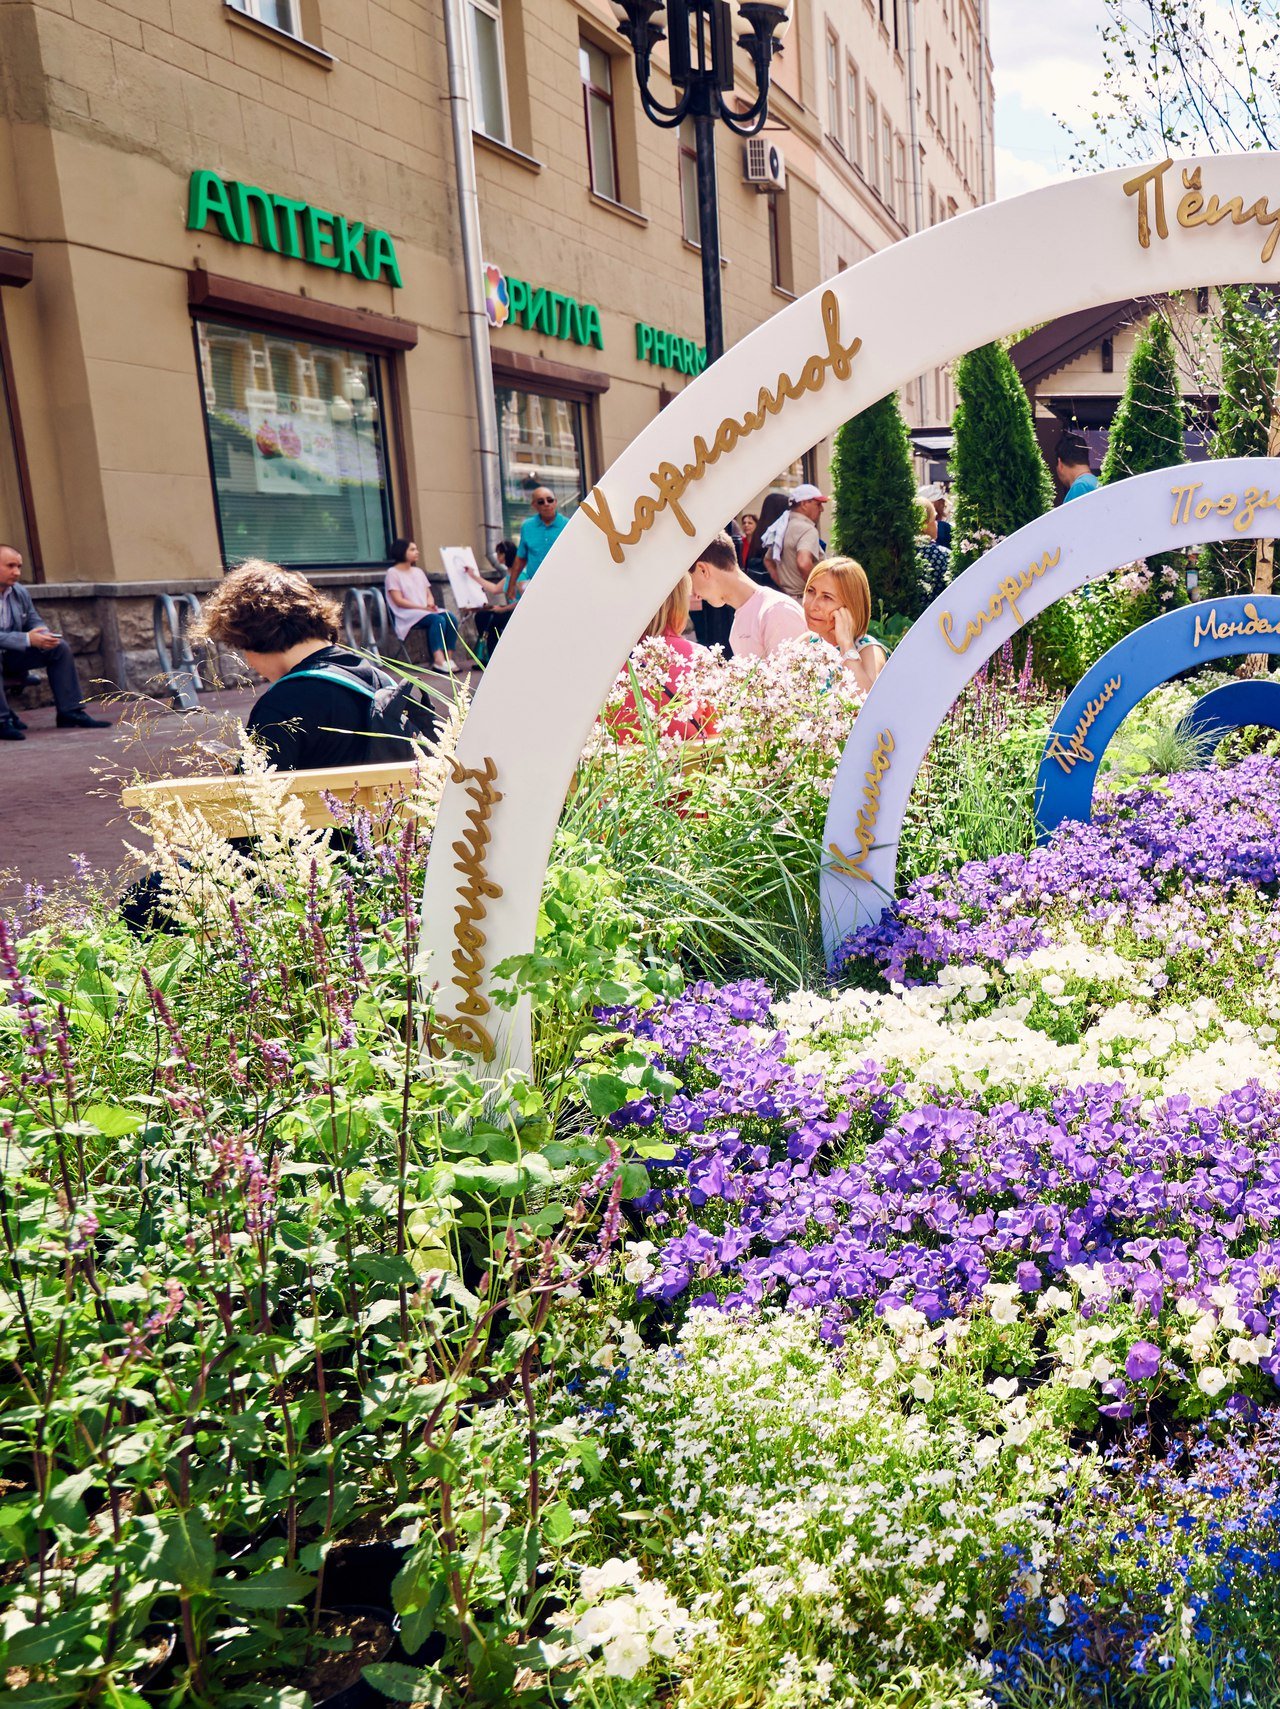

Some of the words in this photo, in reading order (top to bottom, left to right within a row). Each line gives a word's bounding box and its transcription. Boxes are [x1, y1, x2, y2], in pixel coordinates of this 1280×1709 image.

[187, 169, 403, 289] АПТЕКА
[504, 276, 604, 350] РИГЛА
[580, 290, 862, 563] Харламов
[938, 546, 1061, 655] Спорт
[1046, 674, 1122, 774] Пушкин
[829, 728, 896, 882] Космос
[422, 754, 504, 1063] Высоцкий
